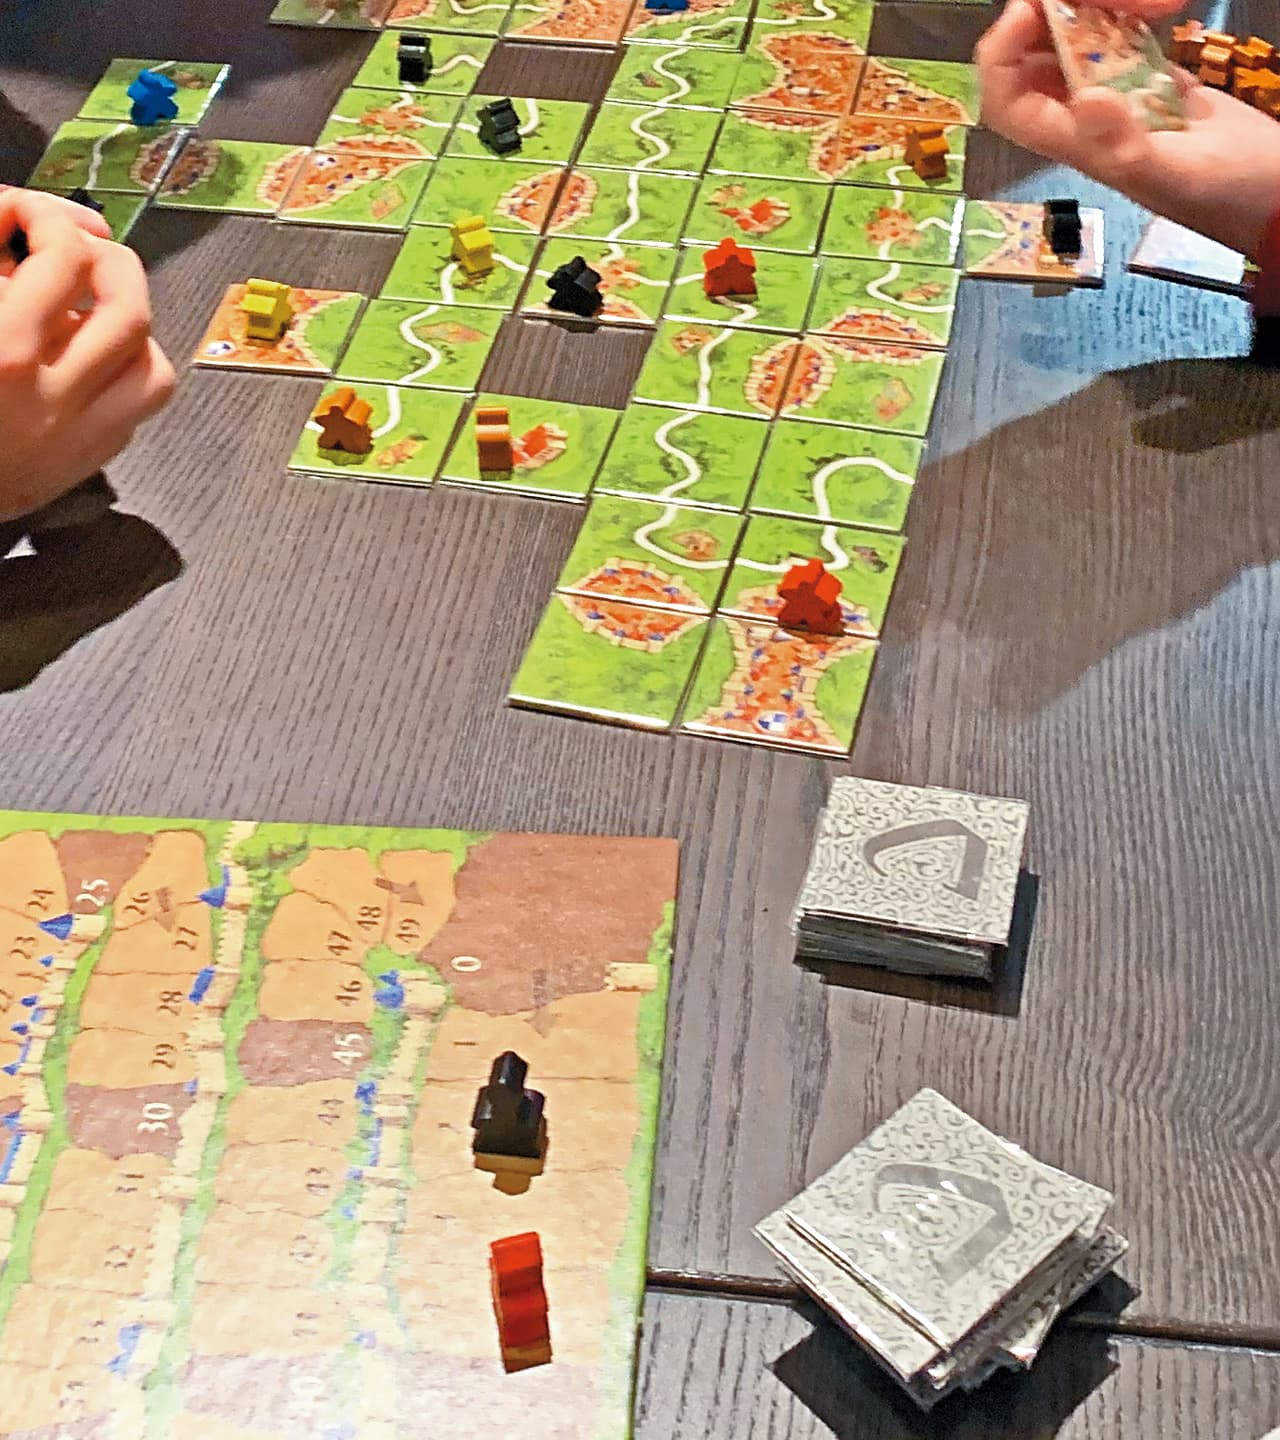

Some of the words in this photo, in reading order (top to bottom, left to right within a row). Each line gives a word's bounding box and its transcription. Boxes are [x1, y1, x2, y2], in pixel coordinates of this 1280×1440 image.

[27, 888, 54, 910] 24
[75, 878, 109, 907] 25
[124, 891, 151, 915] 26
[356, 904, 382, 931] 48
[395, 917, 421, 944] 49
[8, 935, 37, 960] 23
[173, 926, 200, 951] 27
[327, 929, 353, 956] 47
[155, 990, 184, 1016] 28
[334, 979, 362, 1007] 46
[151, 1043, 177, 1070] 29
[331, 1032, 365, 1067] 45
[136, 1102, 174, 1136] 30
